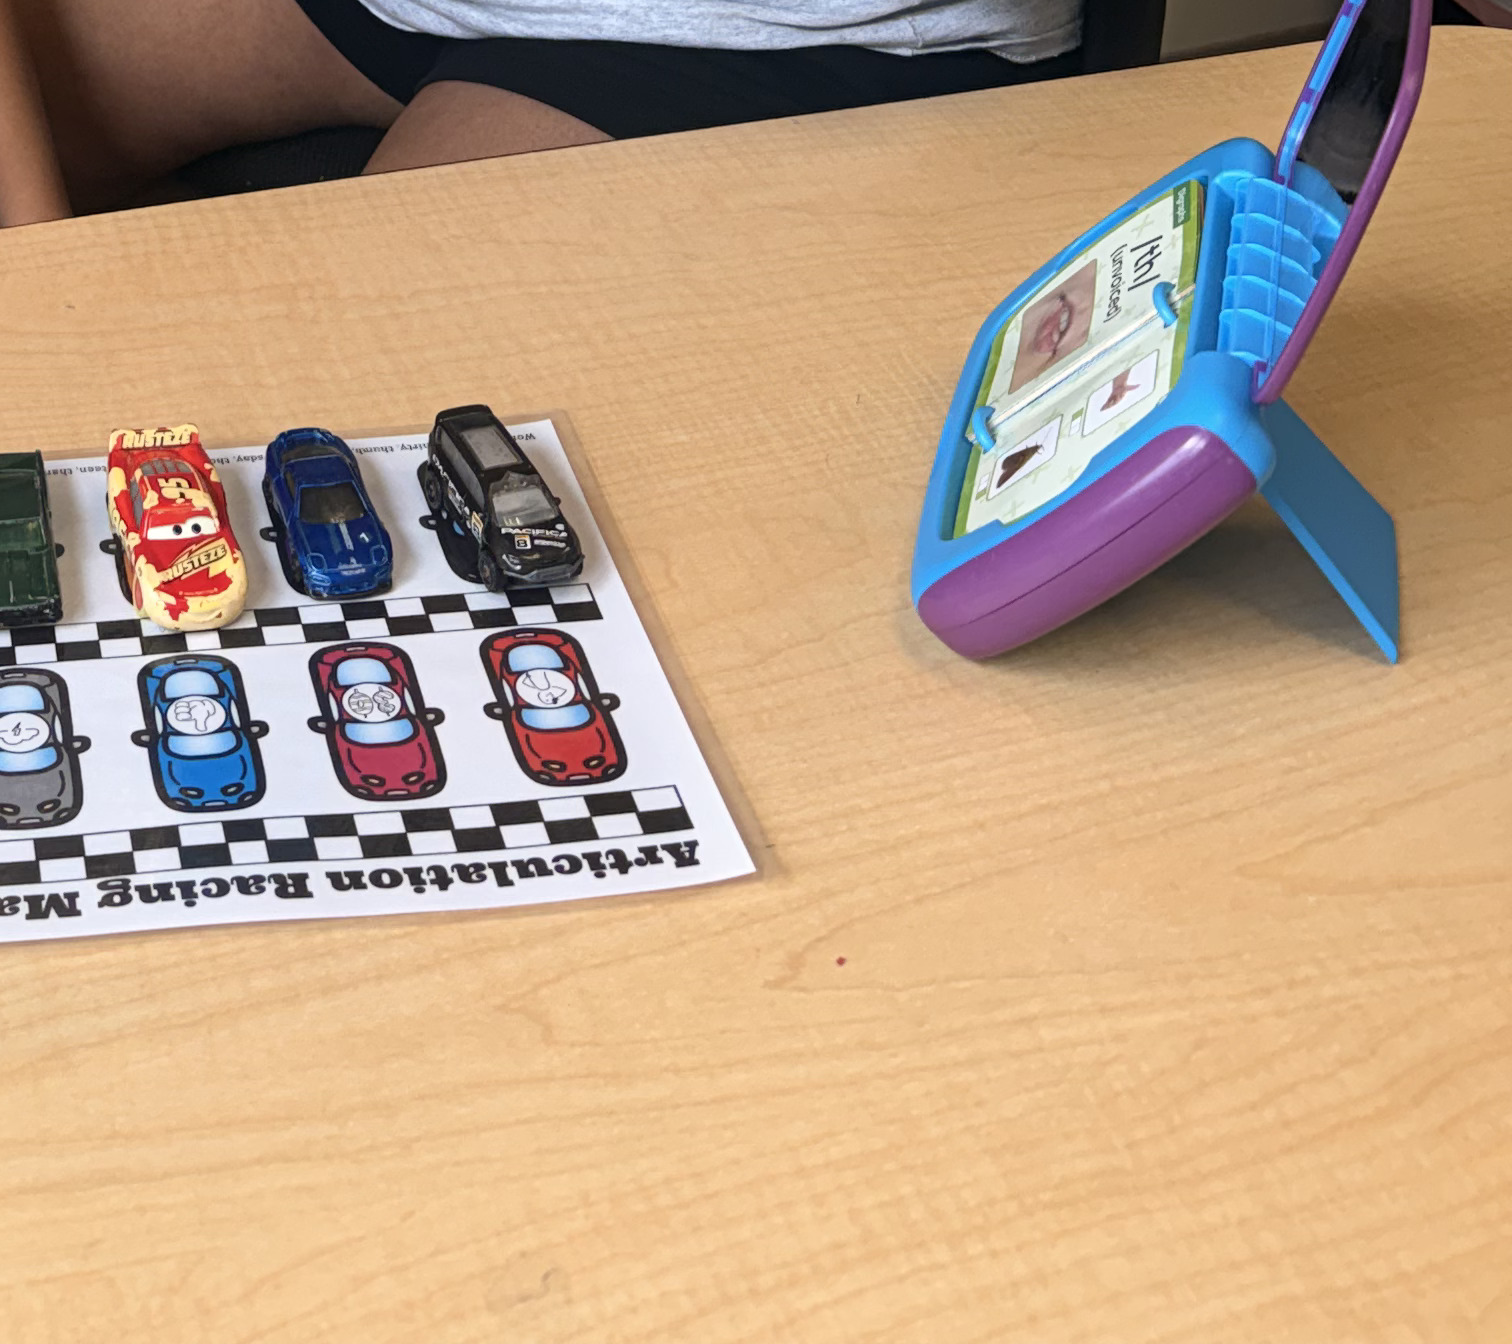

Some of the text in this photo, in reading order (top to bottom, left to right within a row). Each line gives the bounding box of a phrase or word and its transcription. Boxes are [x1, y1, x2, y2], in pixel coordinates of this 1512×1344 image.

[1102, 243, 1128, 323] (unvoiced)
[1127, 234, 1163, 292] /th/
[350, 445, 395, 455] thumb,
[501, 527, 568, 539] PACIFICA
[325, 840, 701, 893] Articulation
[96, 872, 314, 908] Racing
